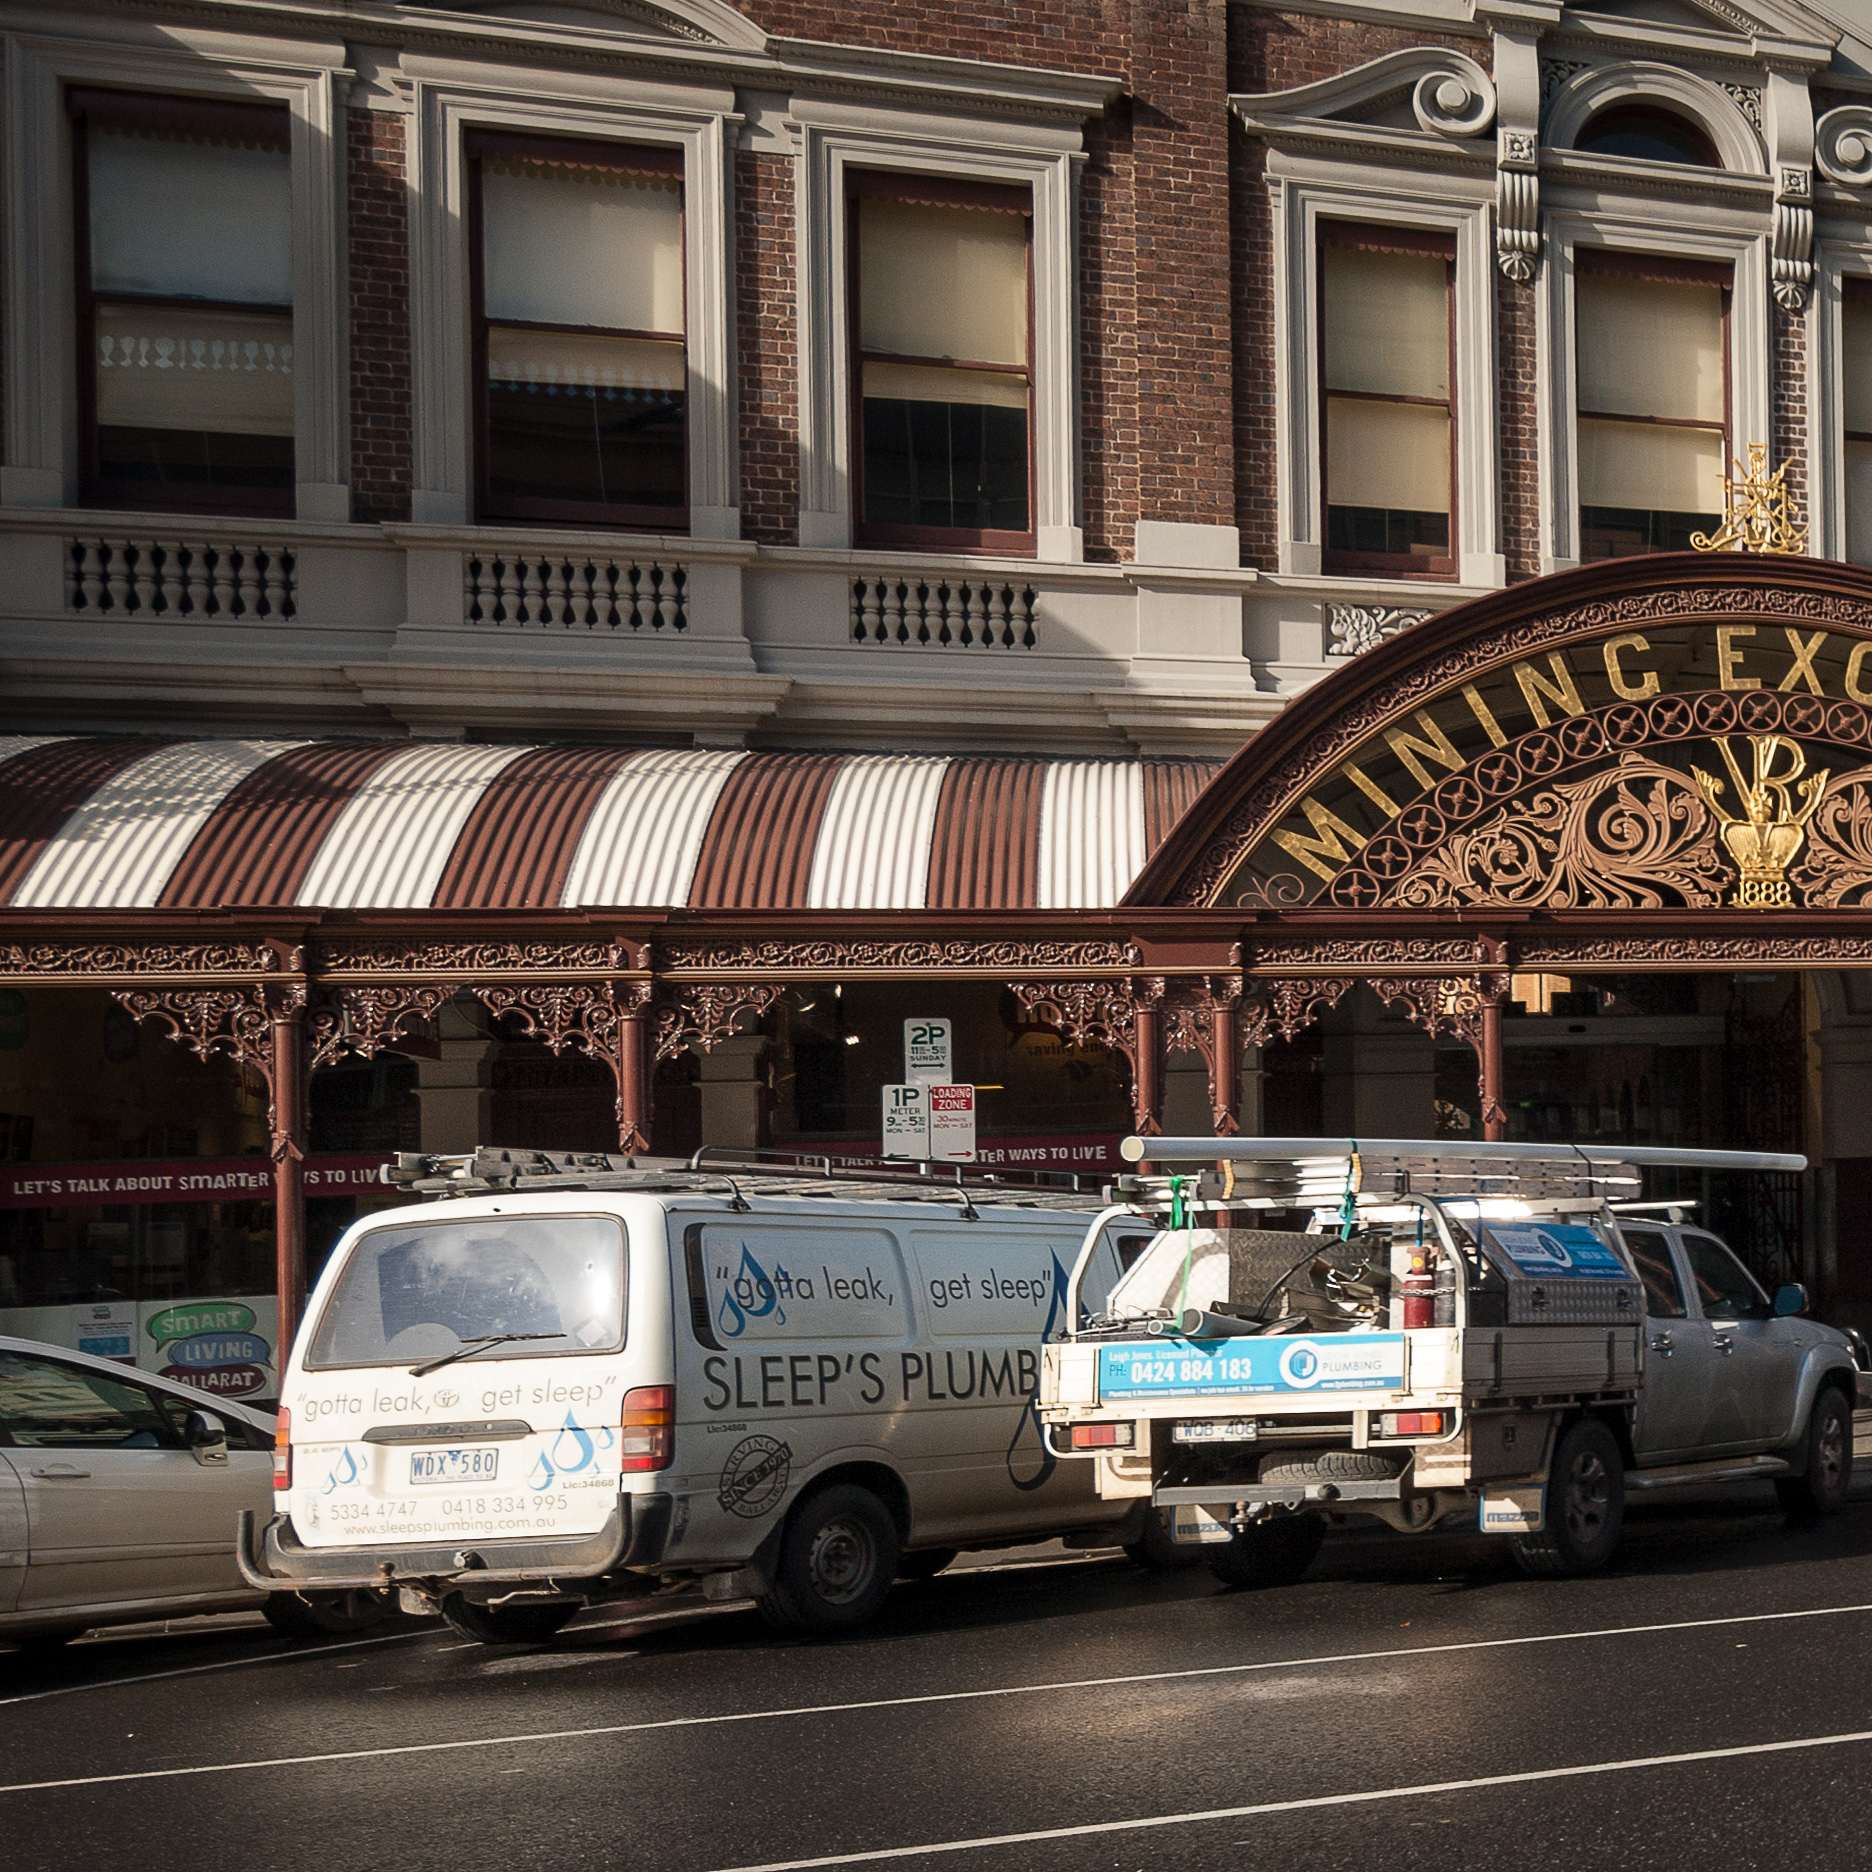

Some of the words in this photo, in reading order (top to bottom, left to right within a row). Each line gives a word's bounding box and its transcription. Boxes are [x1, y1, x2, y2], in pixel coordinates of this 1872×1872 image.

[1270, 632, 1661, 884] MINING
[1738, 879, 1792, 905] 1888
[911, 1026, 946, 1045] 2P
[1026, 1041, 1075, 1057] saving
[892, 1088, 920, 1107] 1P
[933, 1087, 972, 1099] LOADING
[938, 1099, 968, 1110] ZONE
[1006, 1147, 1047, 1162] WAYS
[1050, 1146, 1070, 1160] TO
[1072, 1145, 1107, 1160] LIVE
[12, 1179, 62, 1196] LET'S
[66, 1177, 110, 1194] TALK
[114, 1176, 173, 1193] ABOUT
[178, 1171, 269, 1192] SMARTER
[324, 1169, 346, 1184] TO
[351, 1168, 380, 1184] LIV
[716, 1266, 815, 1311] "gotta
[822, 1265, 894, 1307] leak,
[929, 1272, 973, 1309] get
[981, 1267, 1052, 1308] sleep"
[160, 1310, 242, 1334] SMART
[184, 1340, 254, 1362] LIVING
[1108, 1351, 1130, 1364] Leigh
[1155, 1348, 1190, 1360] Licensed
[1109, 1364, 1127, 1376] PH:
[1131, 1360, 1176, 1384] 0424
[1180, 1359, 1214, 1382] 884
[1219, 1358, 1252, 1380] 183
[1322, 1360, 1383, 1372] PLUMBING
[702, 1352, 887, 1412] SLEEP'S
[297, 1392, 363, 1423] "gotta
[373, 1386, 433, 1416] leak,
[481, 1384, 523, 1413] get
[532, 1376, 617, 1408] sleep"
[412, 1455, 447, 1477] WDX
[461, 1452, 494, 1475] 580
[722, 1468, 764, 1507] SINCE
[762, 1446, 789, 1472] 1970
[562, 1479, 615, 1490] Lic:34868
[330, 1503, 370, 1521] 5334
[376, 1500, 418, 1518] 4747
[442, 1497, 486, 1516] 0418
[492, 1496, 526, 1514] 334
[532, 1494, 568, 1512] 995
